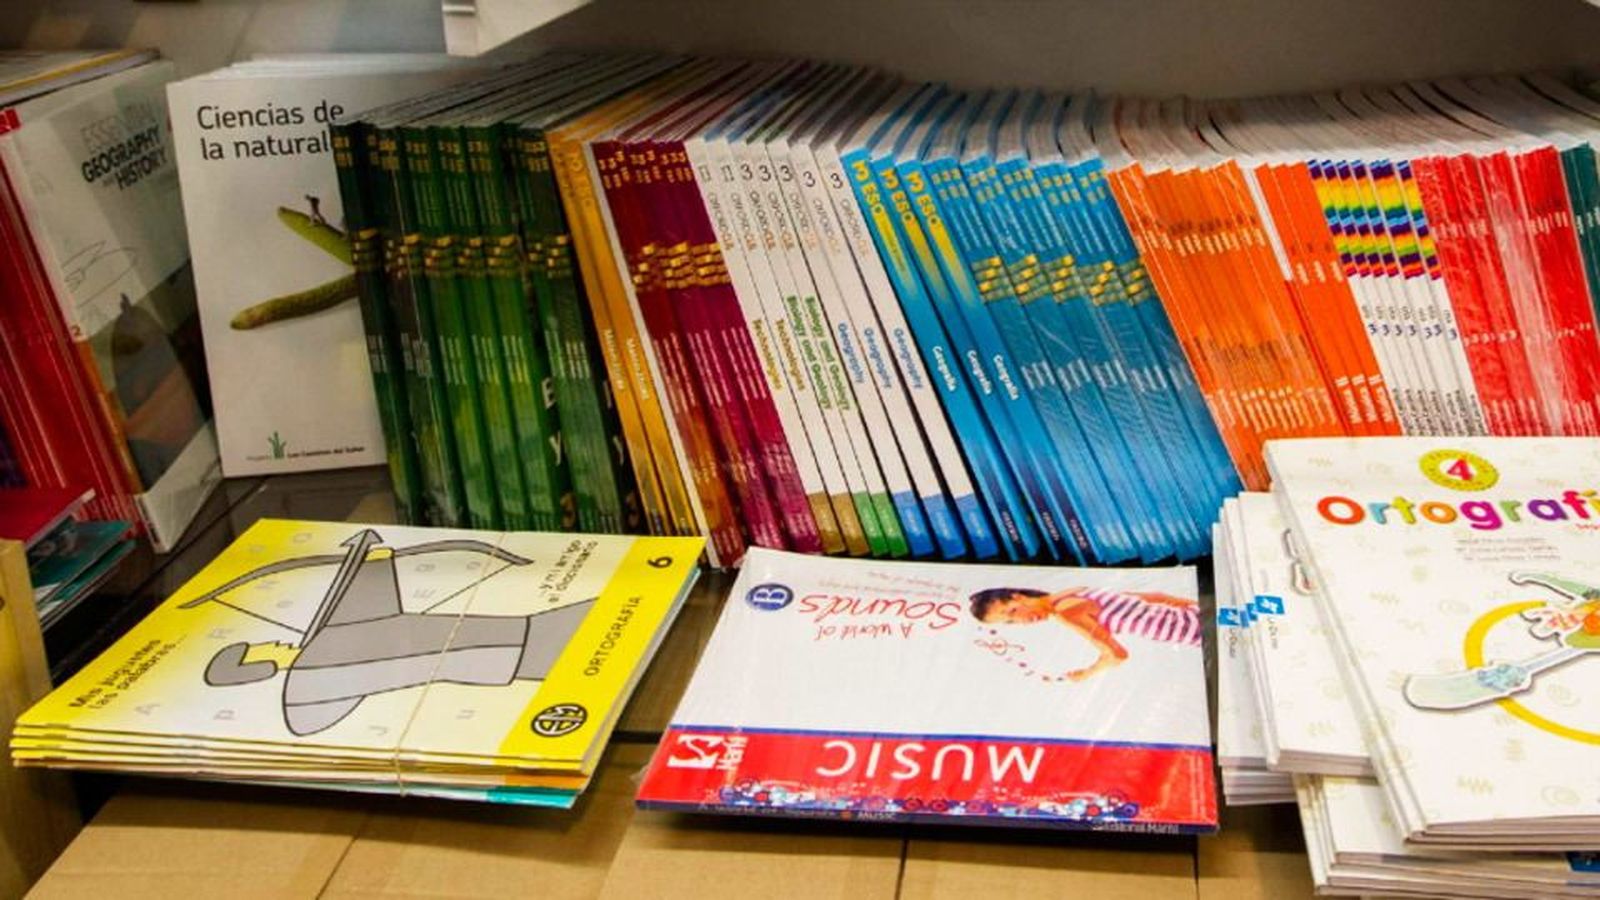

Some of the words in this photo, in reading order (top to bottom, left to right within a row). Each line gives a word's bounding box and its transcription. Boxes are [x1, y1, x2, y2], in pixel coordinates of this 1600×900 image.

[197, 103, 304, 130] Ciencias
[314, 100, 344, 123] de
[82, 124, 160, 183] GEOGRAPHY
[200, 137, 223, 160] la
[114, 146, 166, 190] HISTORY
[740, 163, 753, 181] 3
[758, 164, 771, 182] 3
[780, 164, 794, 182] 3
[852, 160, 870, 181] 3
[880, 168, 899, 189] 3
[803, 171, 816, 188] 3
[830, 173, 844, 190] 3
[907, 171, 925, 192] 3
[838, 323, 865, 384] Geography
[864, 327, 892, 389] Geography
[894, 327, 923, 389] Geography
[1446, 458, 1474, 481] 4
[647, 556, 673, 569] 6
[799, 594, 962, 630] Sounds
[815, 623, 837, 642] of
[900, 622, 914, 640] A
[68, 687, 103, 708] Mis
[98, 639, 161, 687] juguetes
[88, 692, 119, 709] las
[815, 739, 1045, 784] MUSIC
